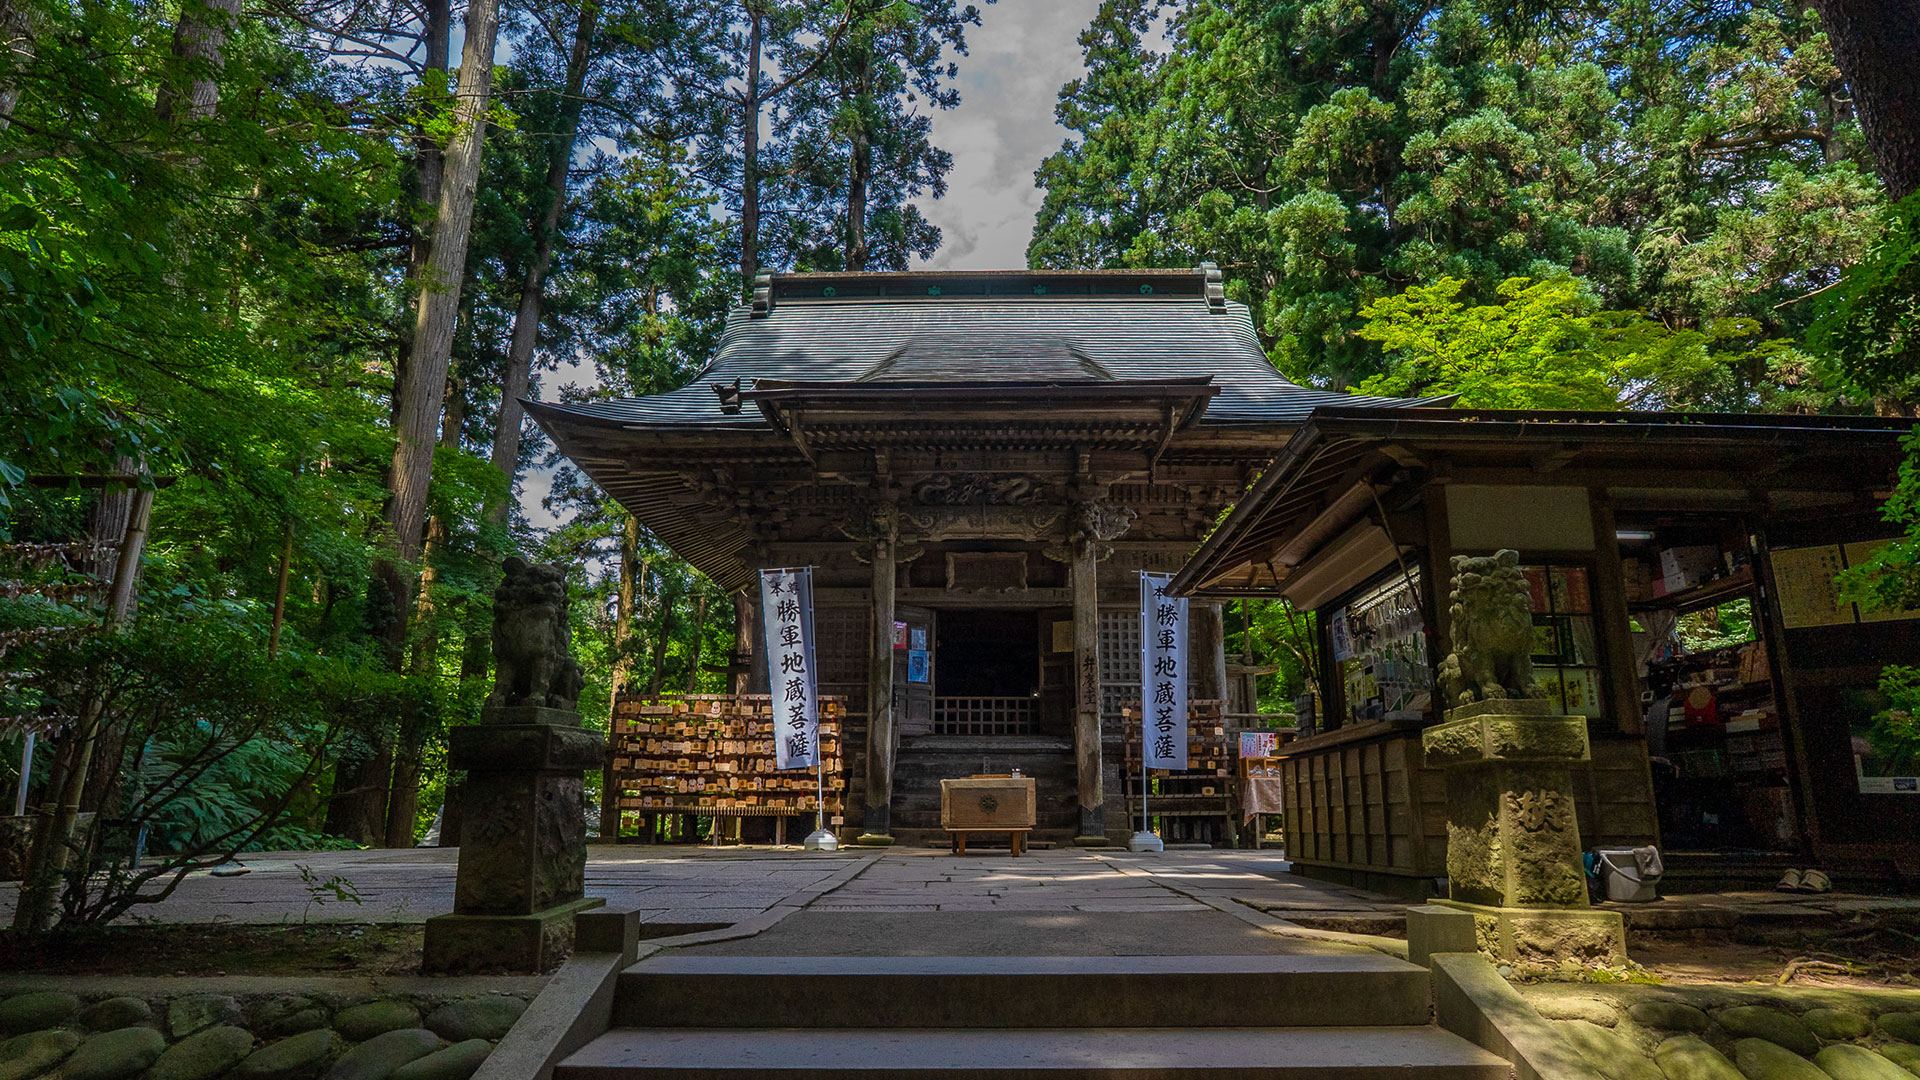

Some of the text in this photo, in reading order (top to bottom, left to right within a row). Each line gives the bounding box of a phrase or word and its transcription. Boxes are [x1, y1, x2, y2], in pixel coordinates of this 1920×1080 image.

[776, 599, 811, 758] 勝軍地蔵菩薩
[1153, 603, 1179, 759] 勝軍地蔵菩薩
